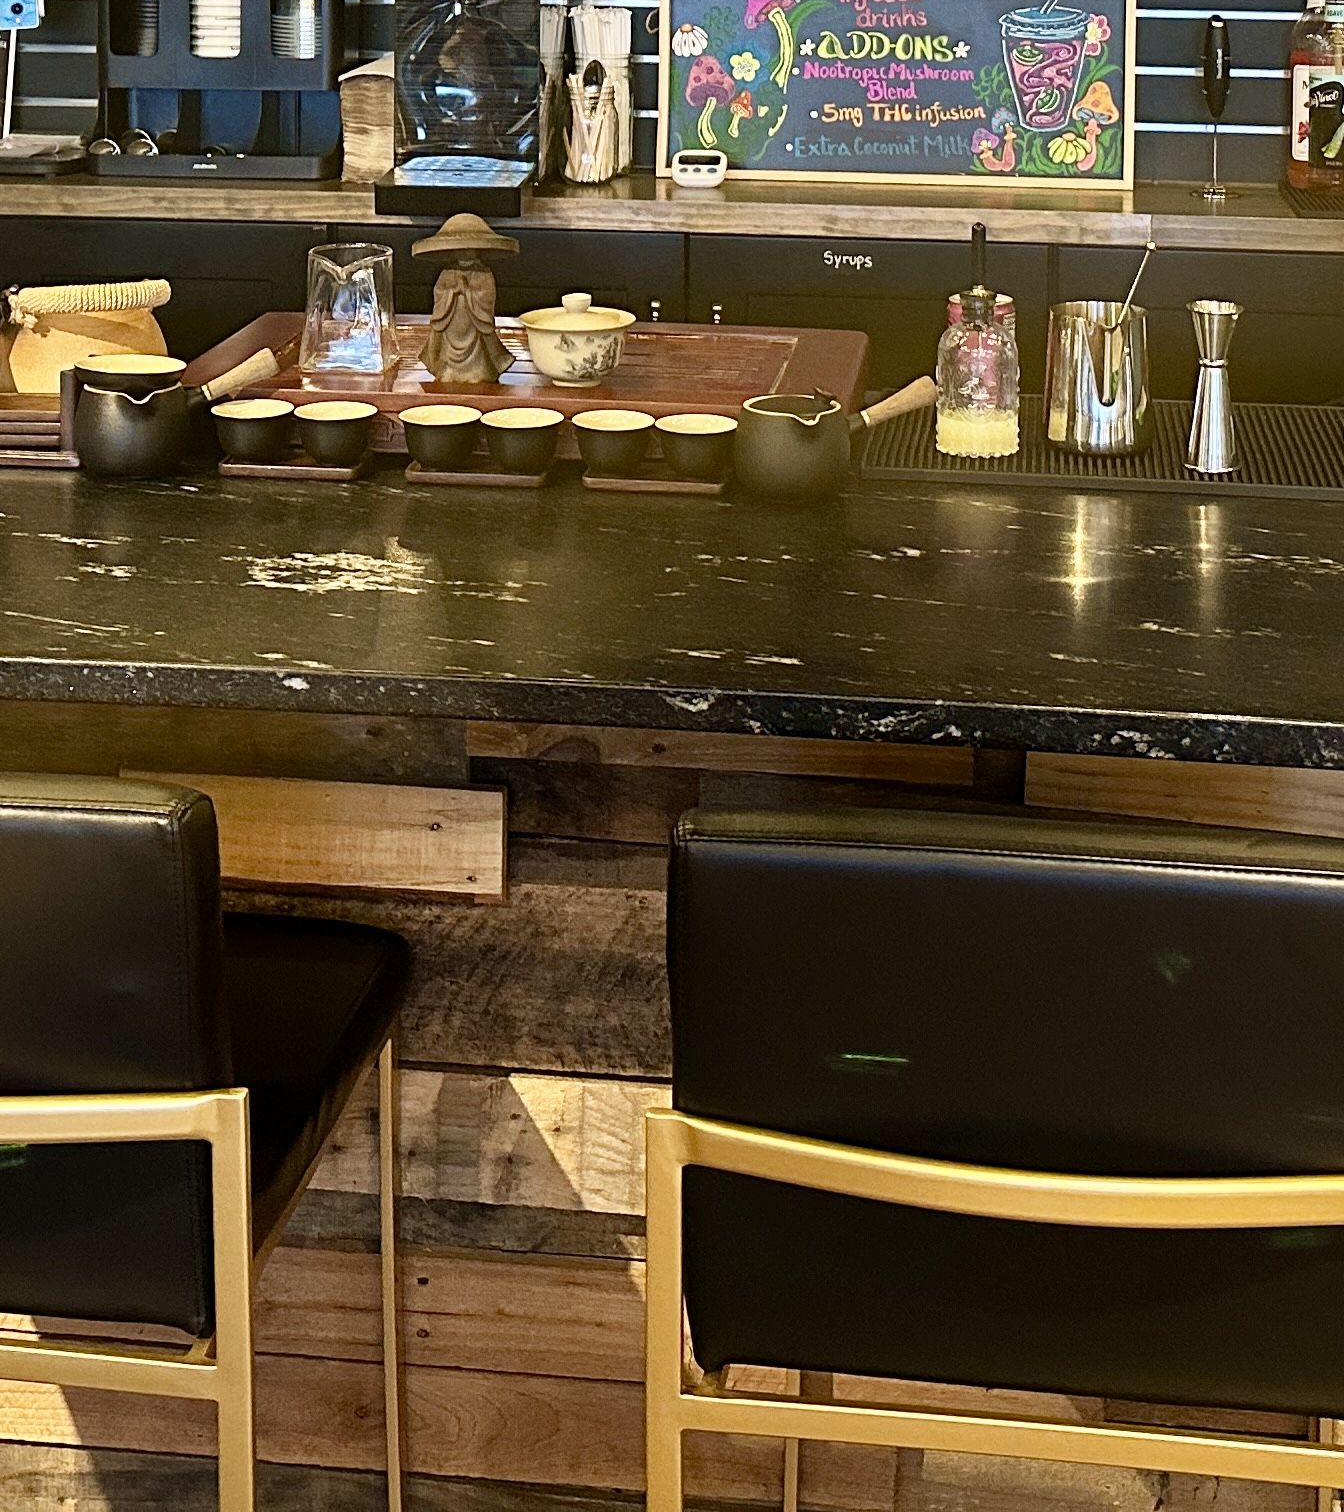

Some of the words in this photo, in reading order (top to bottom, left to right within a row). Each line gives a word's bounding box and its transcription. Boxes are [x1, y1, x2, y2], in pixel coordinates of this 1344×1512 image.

[803, 61, 888, 87] Nootropic
[889, 63, 974, 81] Mushroom
[867, 81, 917, 101] Blend
[821, 104, 863, 127] 5mg
[867, 103, 912, 121] THC
[915, 102, 986, 127] infusion
[794, 136, 851, 157] Extra
[855, 138, 919, 155] Coconut
[824, 250, 872, 270] Syrups
